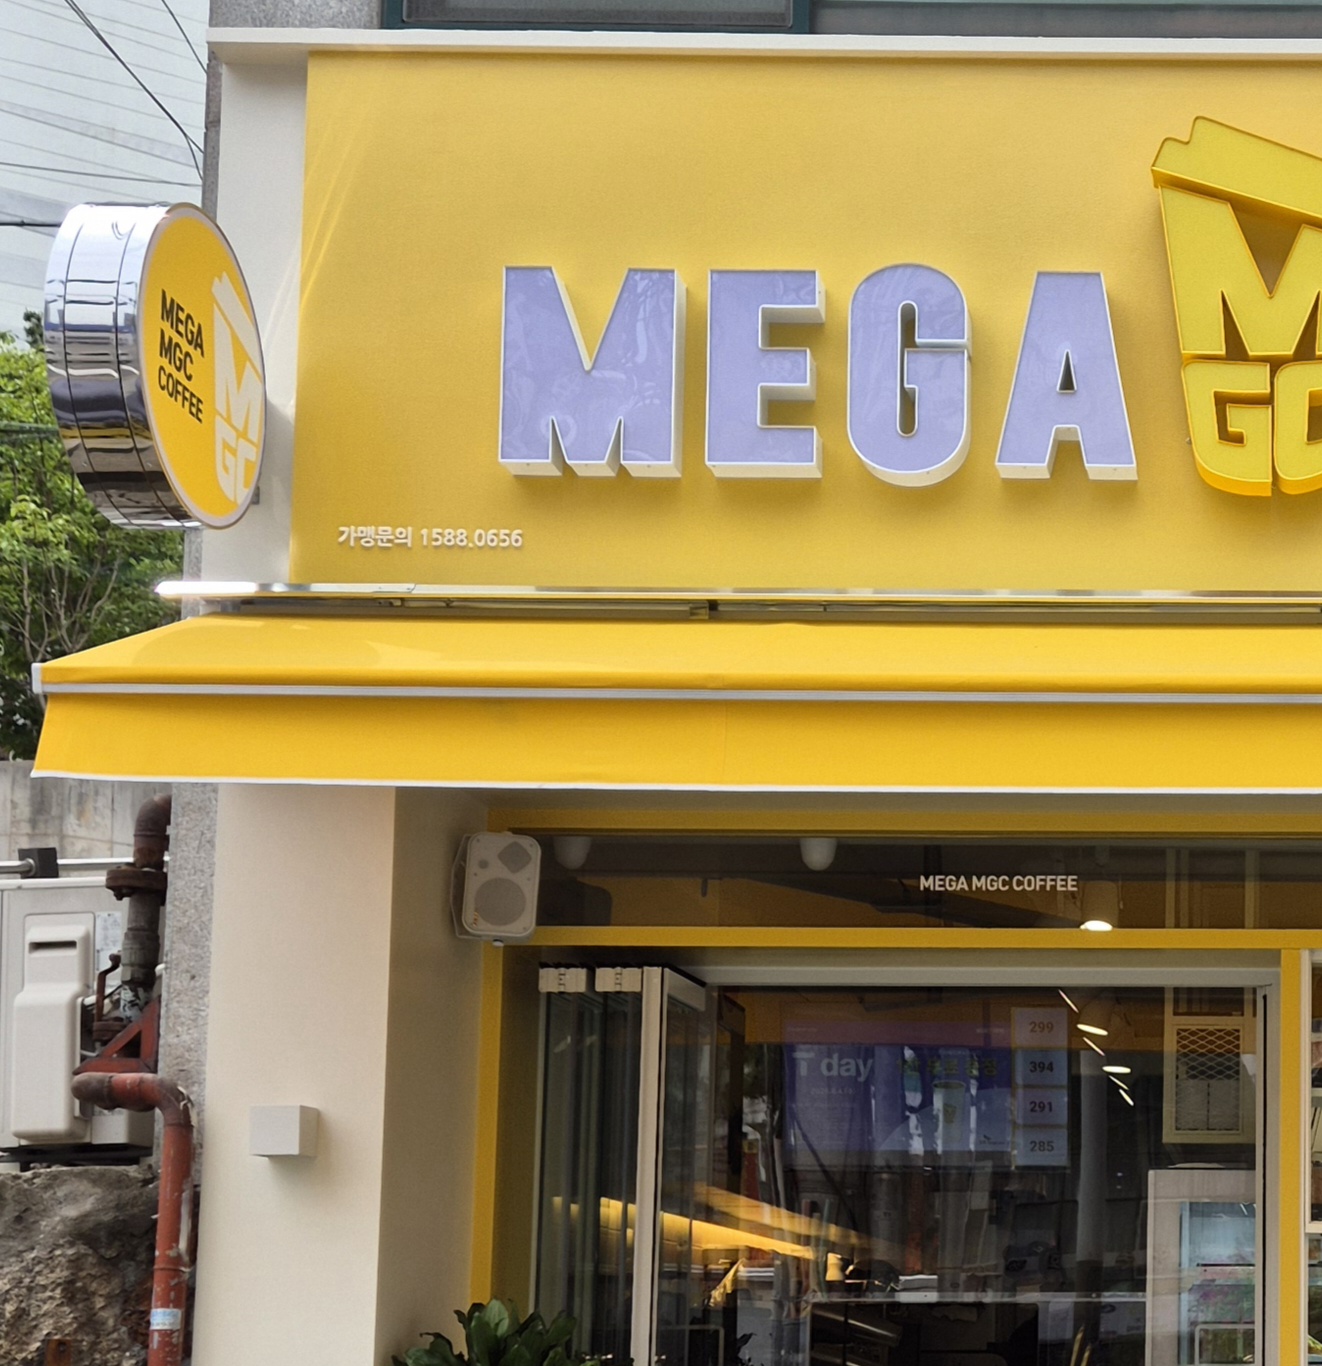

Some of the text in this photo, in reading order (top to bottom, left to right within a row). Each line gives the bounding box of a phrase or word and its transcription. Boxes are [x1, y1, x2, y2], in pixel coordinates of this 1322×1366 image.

[160, 289, 204, 358] MEGA
[158, 328, 194, 382] MGC
[499, 263, 1138, 485] MEGA
[157, 365, 204, 424] COFFEE
[337, 525, 523, 548] 가맹문의 1588.0656
[920, 875, 1078, 891] MEGA MGC COFFEE
[1029, 1021, 1054, 1034] 299
[820, 1053, 874, 1082] day
[1029, 1061, 1054, 1073] 394
[1029, 1101, 1053, 1113] 291
[1029, 1140, 1054, 1152] 285
